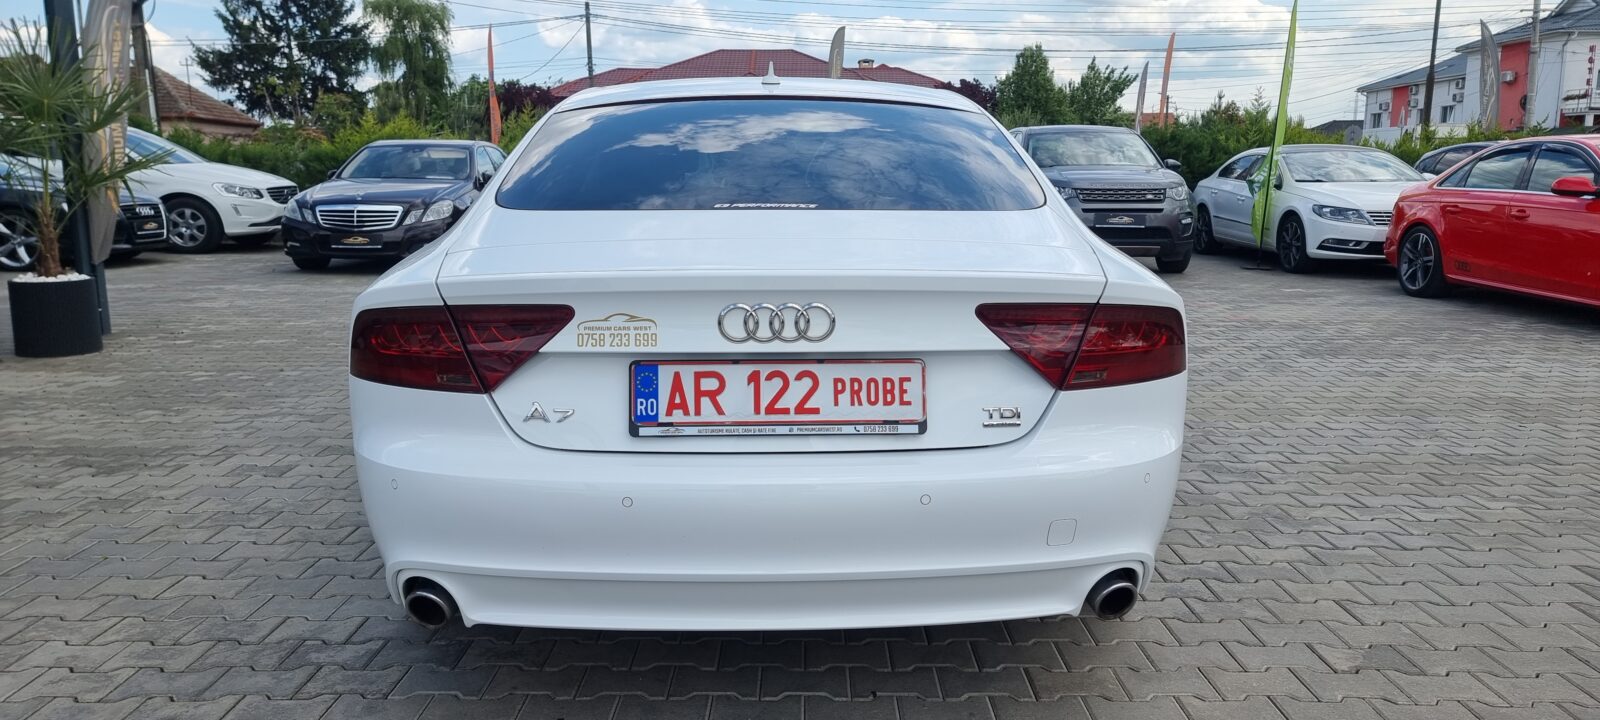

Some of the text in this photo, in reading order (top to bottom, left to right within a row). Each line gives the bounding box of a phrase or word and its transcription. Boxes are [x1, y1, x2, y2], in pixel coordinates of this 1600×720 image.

[577, 332, 658, 348] 0758 233 699
[665, 369, 913, 417] AR 122 PROBE
[522, 401, 575, 423] A7
[636, 398, 657, 416] RO
[982, 407, 1021, 420] TDI
[863, 425, 877, 433] 0758
